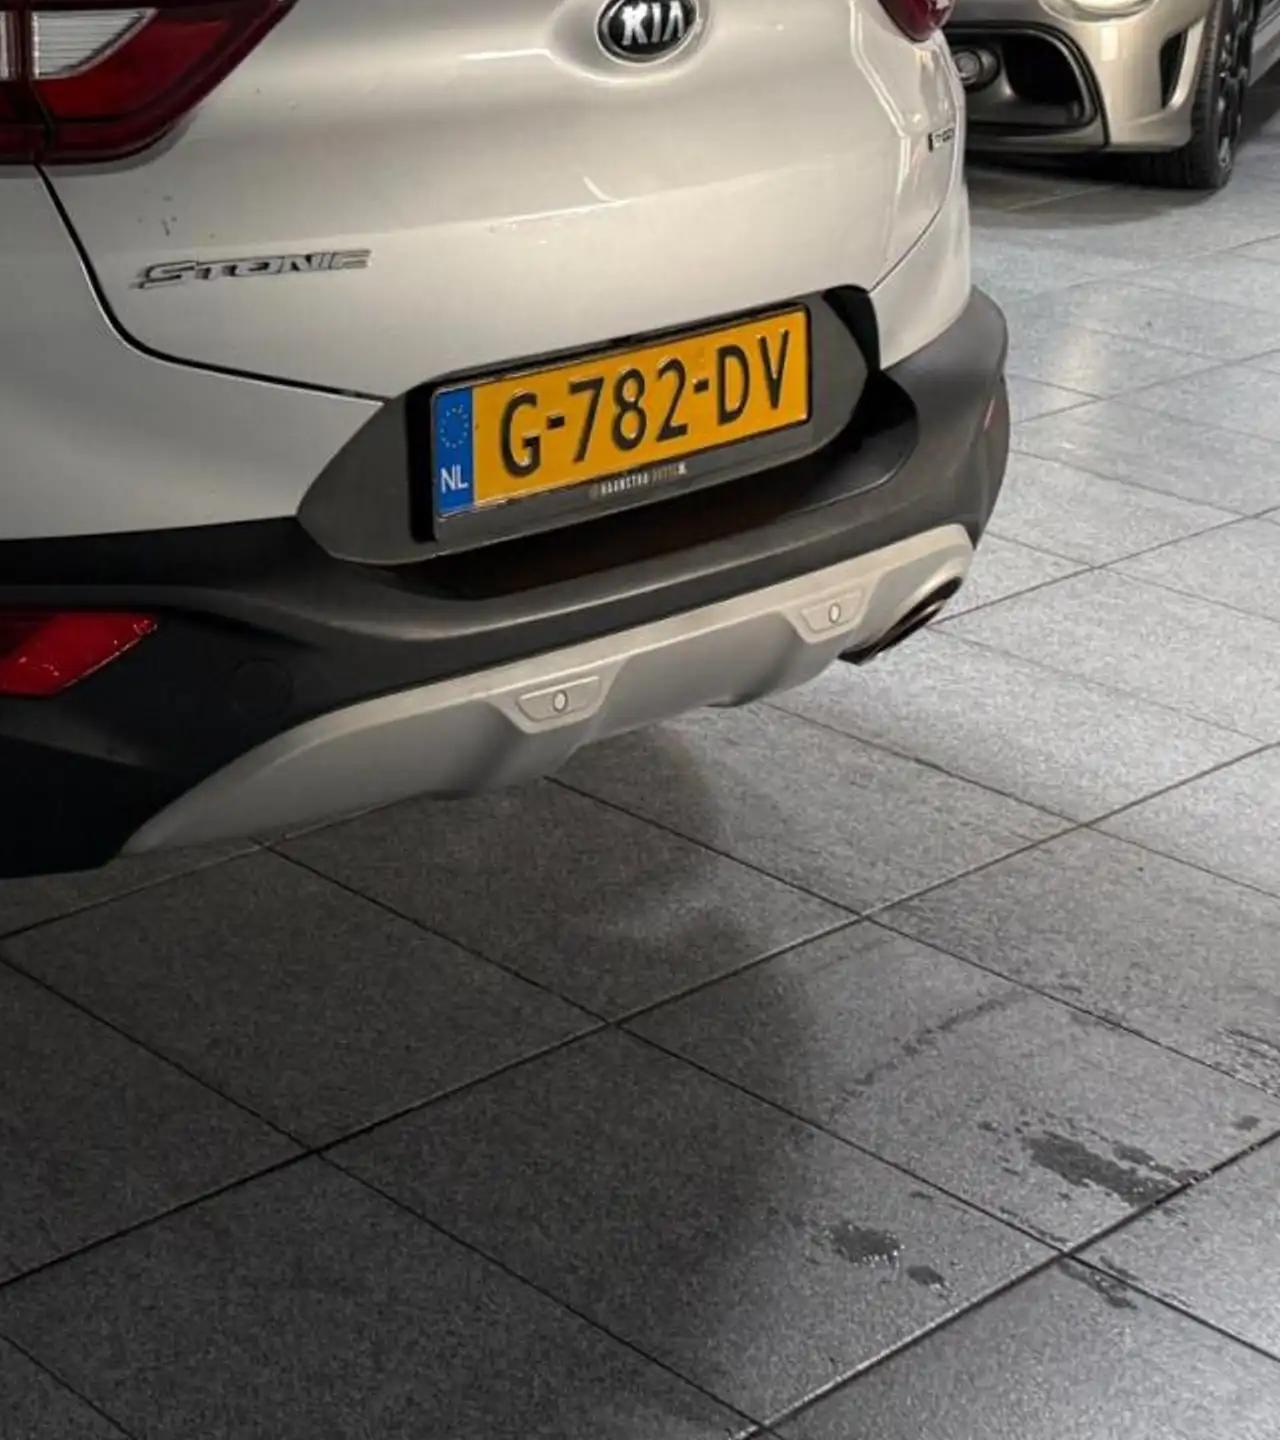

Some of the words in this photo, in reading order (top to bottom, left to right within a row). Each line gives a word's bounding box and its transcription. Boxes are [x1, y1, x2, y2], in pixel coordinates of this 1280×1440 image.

[620, 0, 687, 47] KIA
[501, 329, 791, 478] G-782-DV
[440, 464, 469, 495] NL
